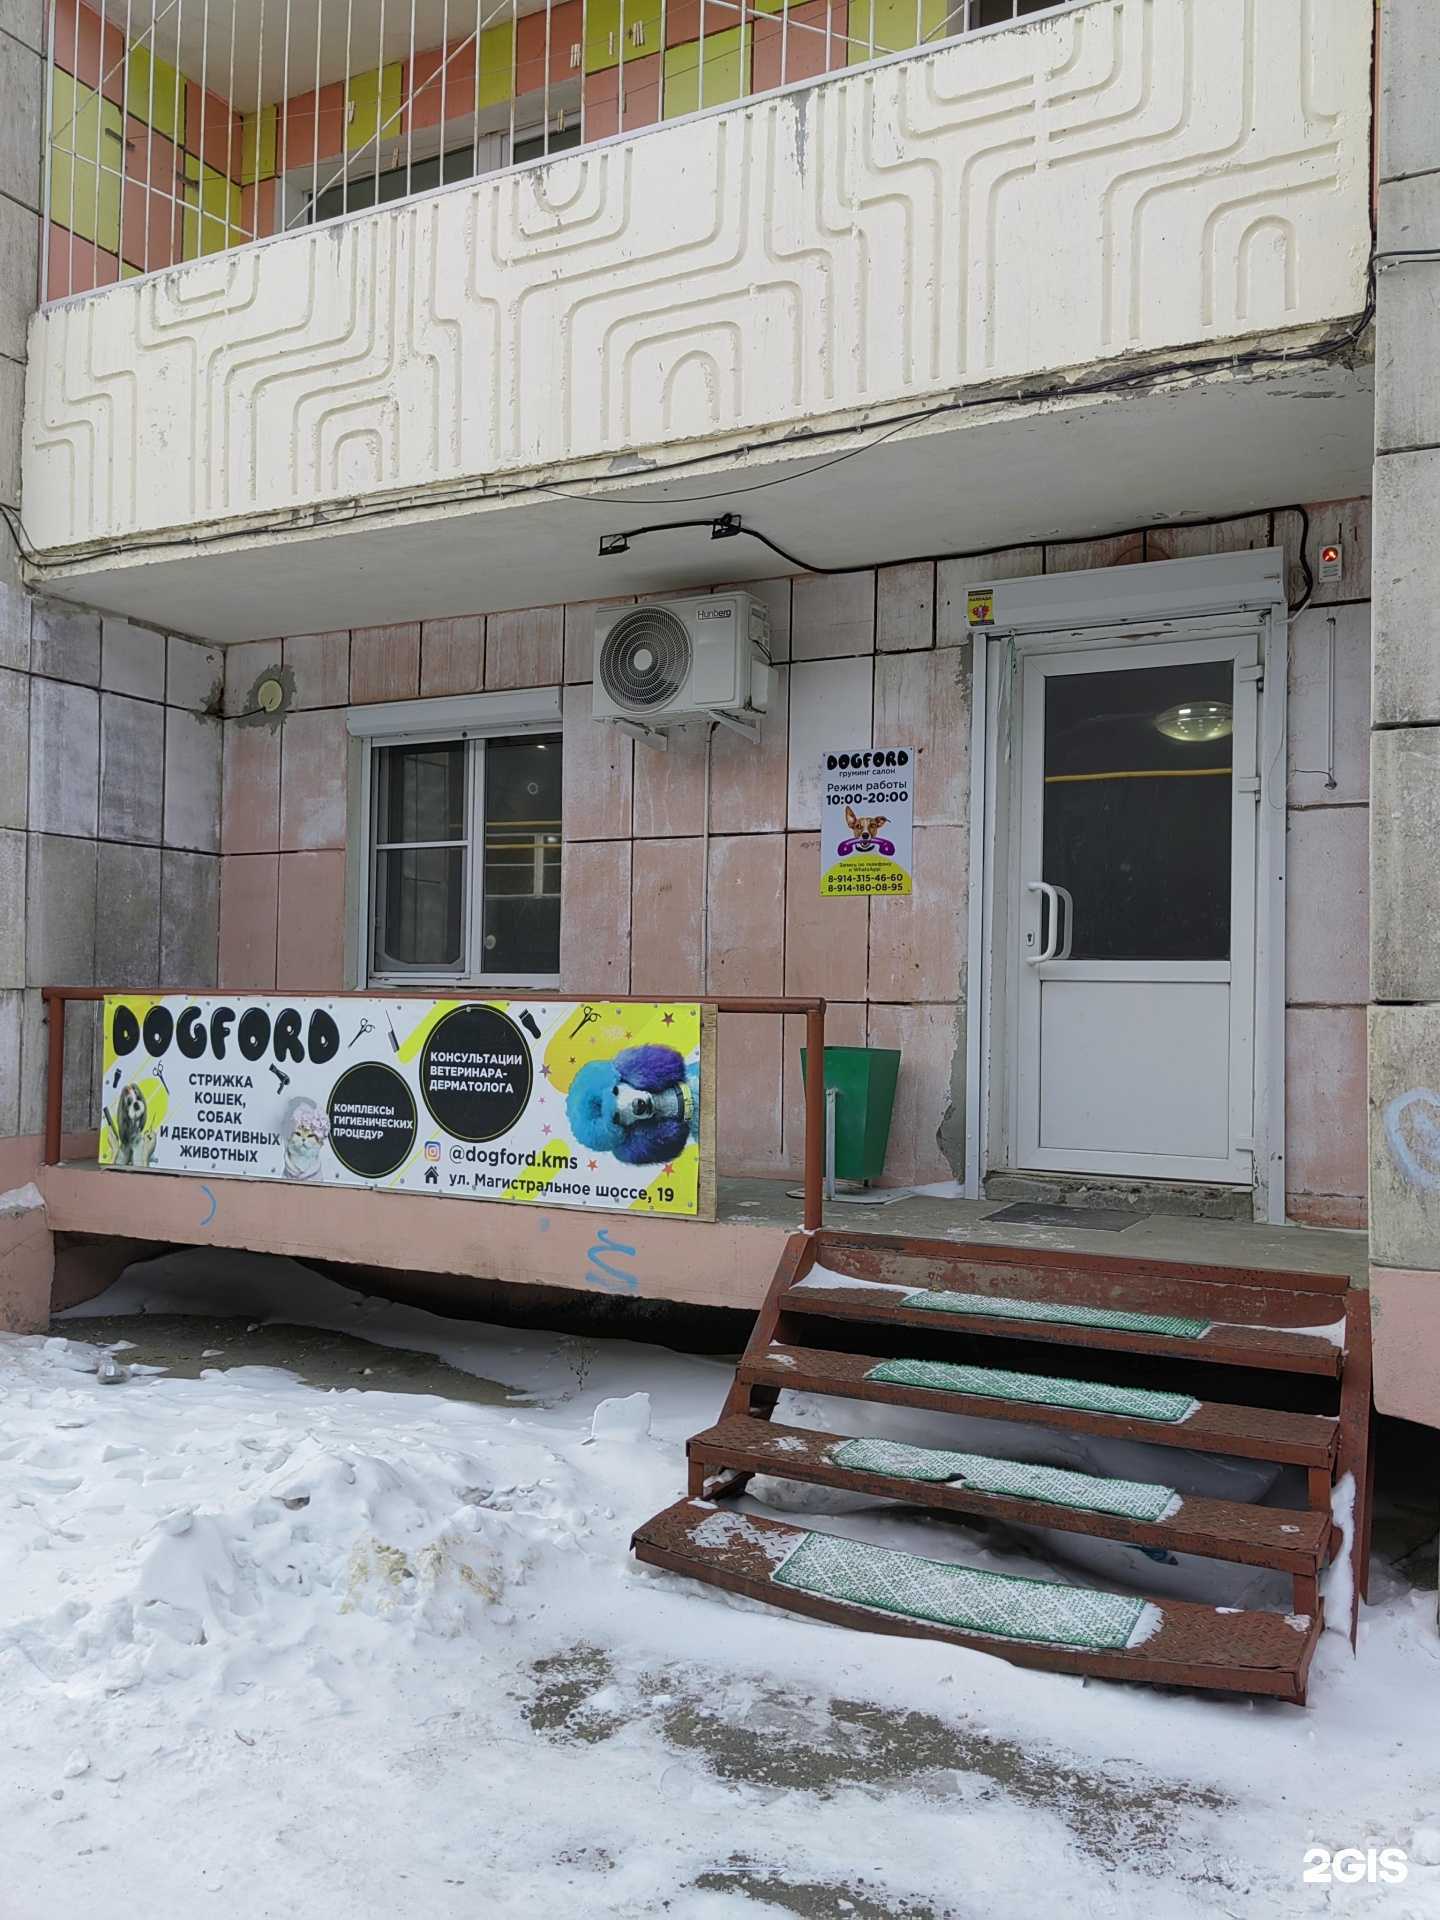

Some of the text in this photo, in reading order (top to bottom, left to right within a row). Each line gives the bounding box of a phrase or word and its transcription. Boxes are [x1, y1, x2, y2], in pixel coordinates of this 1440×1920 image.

[827, 750, 909, 770] DOGFORD
[839, 768, 896, 778] груминг салон
[827, 780, 907, 793] Режим работы
[826, 791, 909, 806] 10:00-20:00
[828, 873, 903, 883] 8-914-315-46-60
[828, 883, 903, 892] 8-914-180-08-95
[112, 1005, 340, 1065] DOGFORD
[430, 1051, 523, 1066] КОНСУЛЬТАЦИИ
[429, 1066, 508, 1079] ВЕТЕРИНАРА-
[188, 1073, 253, 1089] СТРИЖКА
[429, 1079, 514, 1094] ДЕРМАТОЛОГА
[194, 1091, 247, 1108] КОШЕК,
[333, 1103, 395, 1116] КОМПЛЕКСЫ
[197, 1110, 243, 1125] СОБАК
[333, 1116, 414, 1130] ГИГИЕНИЧЕСКИХ
[160, 1126, 281, 1146] И ДЕКОРАТИВНЫХ
[333, 1127, 384, 1140] ПРОЦЕДУР
[179, 1145, 259, 1163] ЖИВОТНЫХ
[449, 1145, 579, 1170] @dogford.kms
[449, 1173, 675, 1203] ул. Магистральное шоссе, 19
